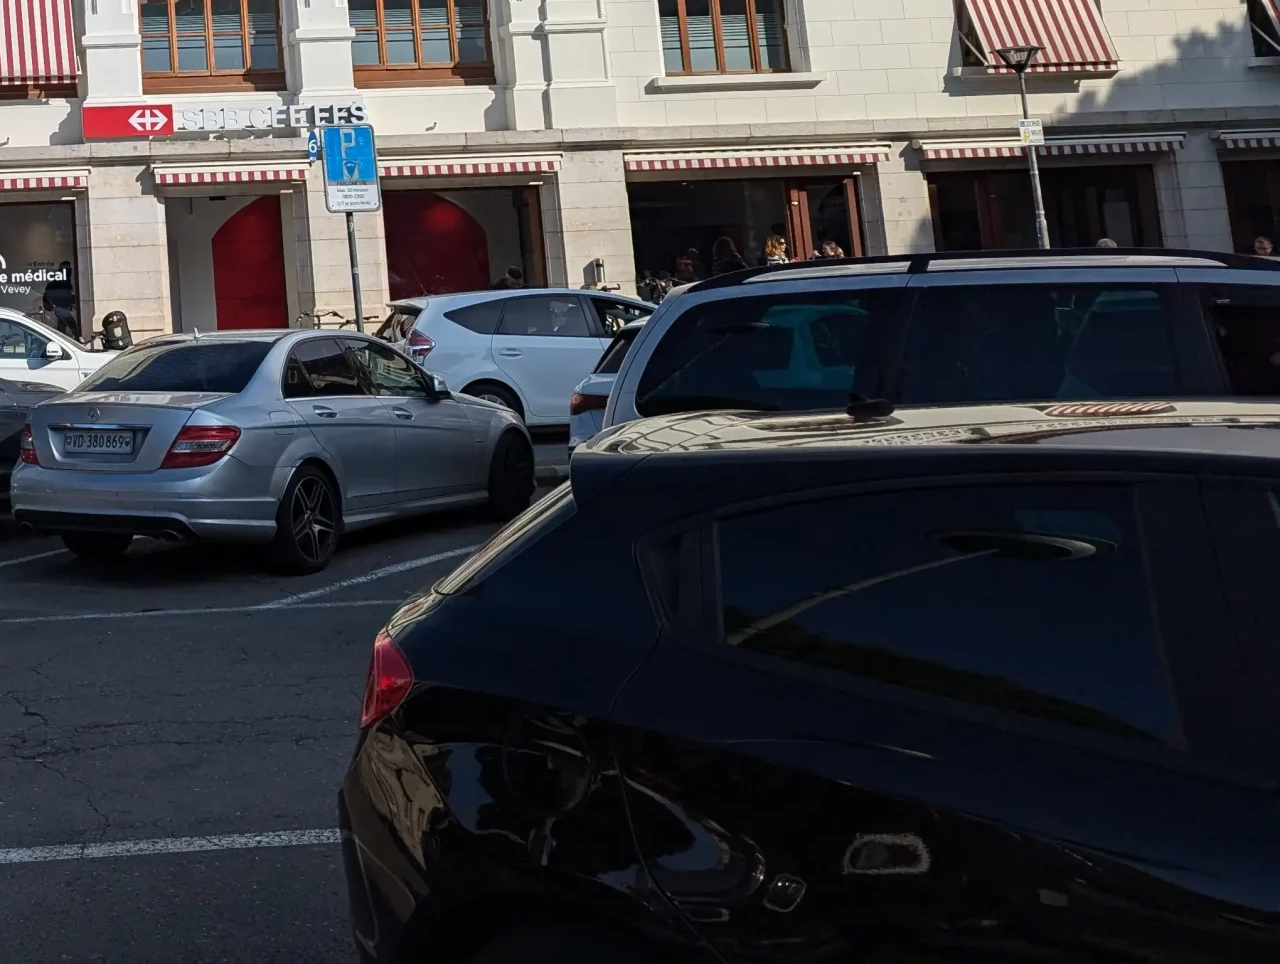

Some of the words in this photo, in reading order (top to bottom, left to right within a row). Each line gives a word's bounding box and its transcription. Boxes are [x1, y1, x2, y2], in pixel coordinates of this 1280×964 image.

[182, 107, 239, 131] SBB
[308, 139, 318, 153] 6
[339, 128, 356, 160] P
[11, 268, 67, 283] médical
[1, 285, 31, 295] Vevey
